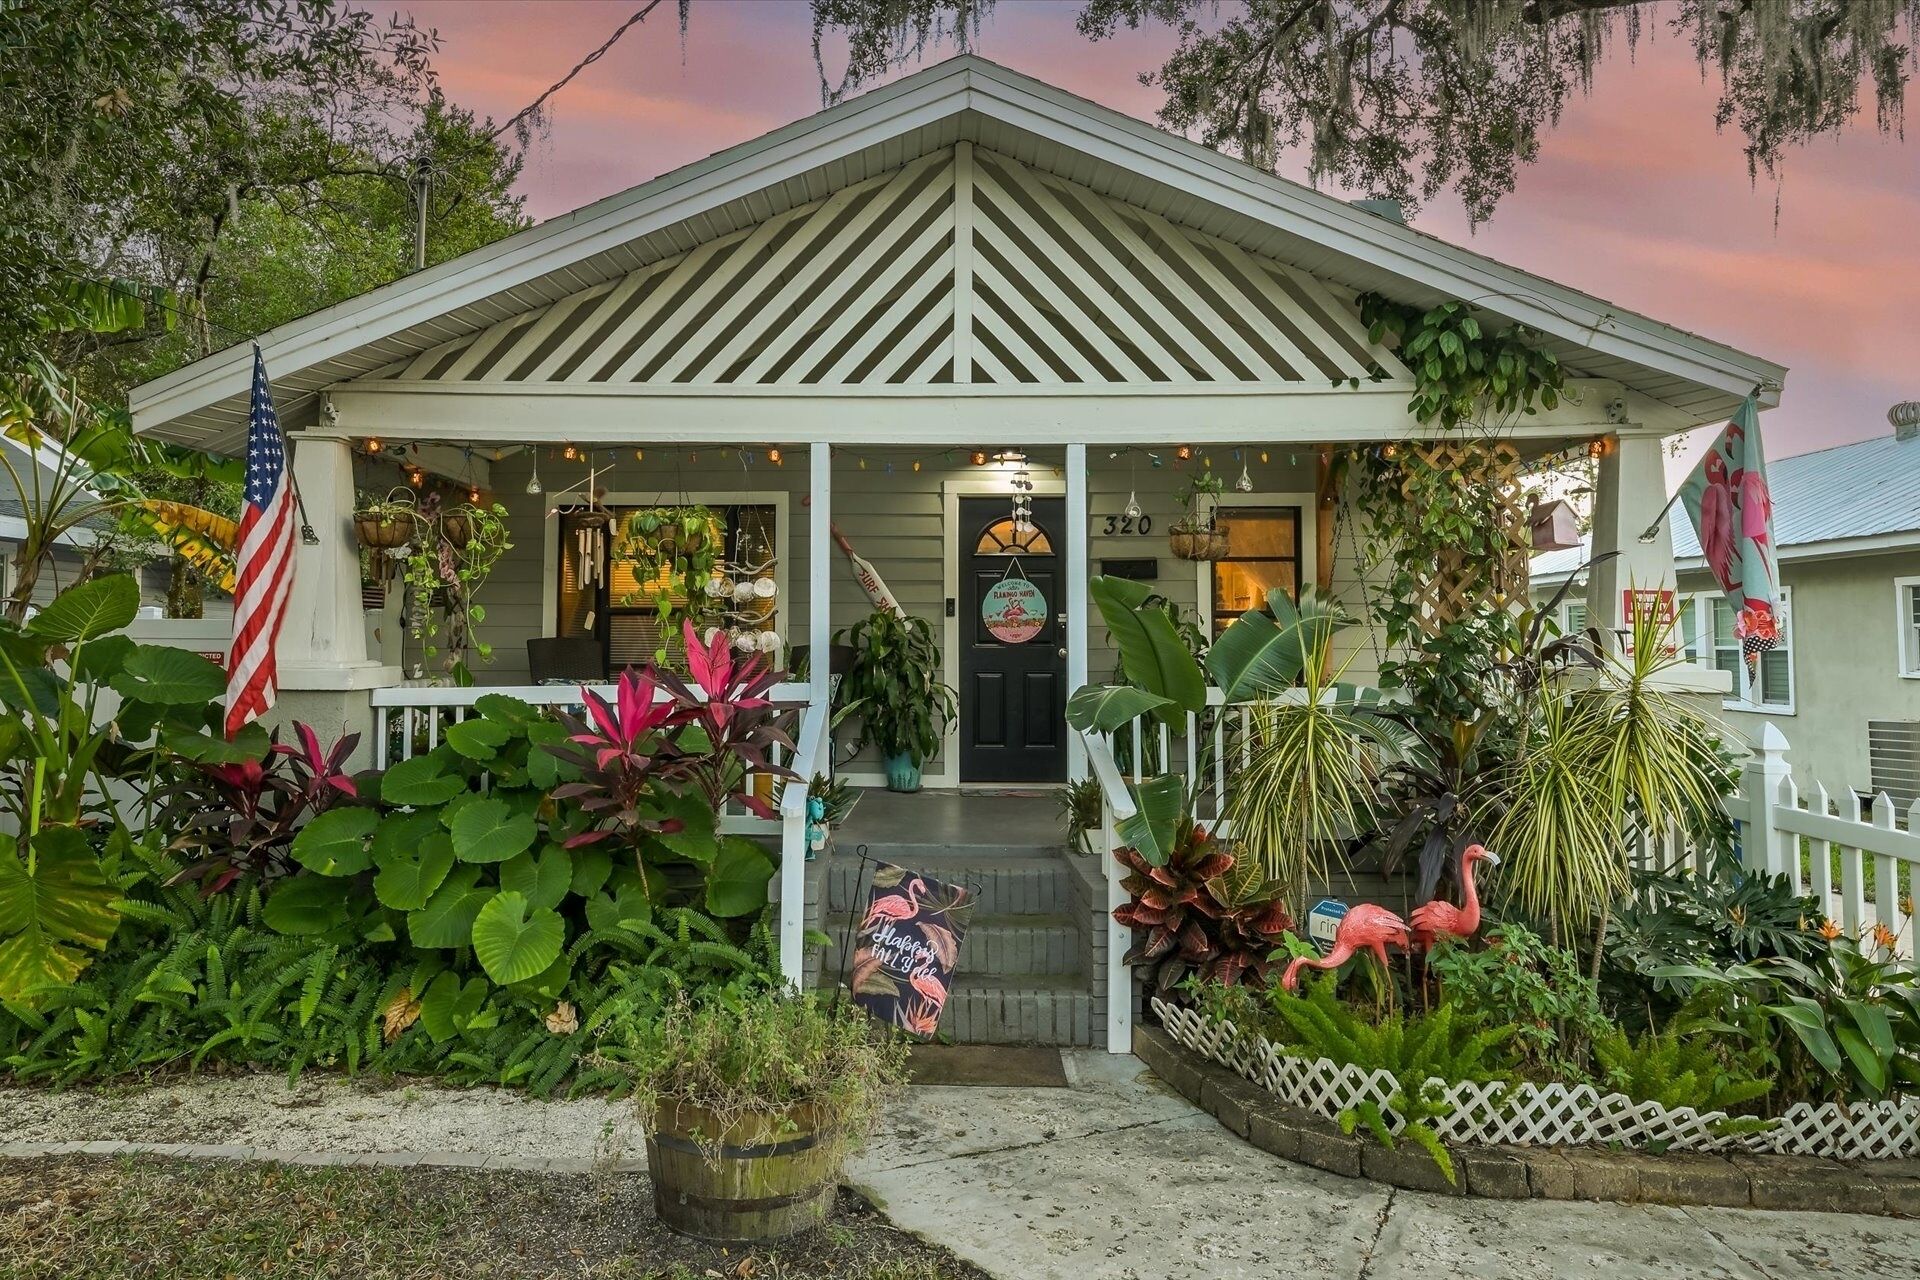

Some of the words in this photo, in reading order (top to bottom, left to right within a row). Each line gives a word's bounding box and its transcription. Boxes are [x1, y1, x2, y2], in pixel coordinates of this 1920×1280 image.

[1104, 515, 1151, 535] 320
[859, 570, 879, 593] SURF
[996, 581, 1020, 589] WELCOME
[871, 943, 899, 968] FALL
[872, 924, 939, 964] Happy
